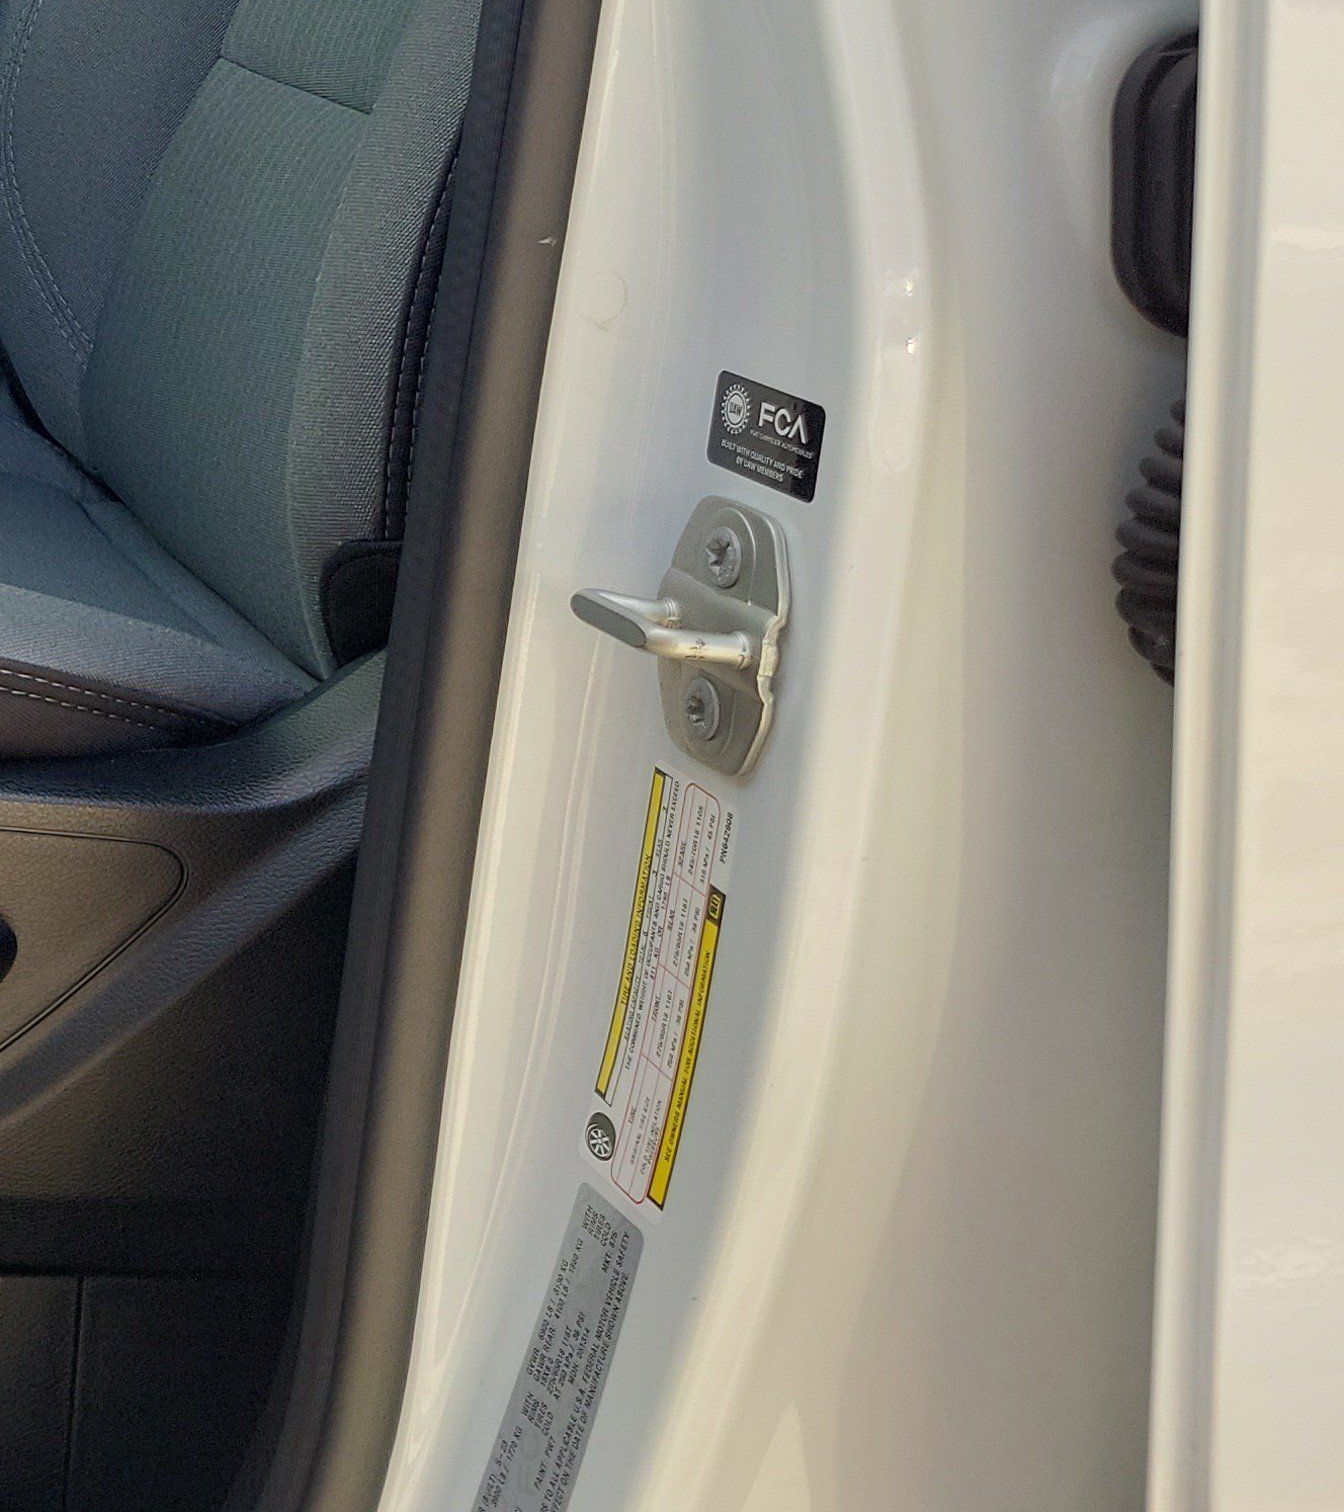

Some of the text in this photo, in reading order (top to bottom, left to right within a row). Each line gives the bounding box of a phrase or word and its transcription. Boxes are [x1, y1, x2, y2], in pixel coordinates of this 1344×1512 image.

[758, 400, 809, 444] FCA
[599, 1221, 611, 1247] COLD
[543, 1488, 553, 1501] TO
[548, 1471, 559, 1488] ALL
[554, 1413, 577, 1469] APPLICABLE
[581, 1342, 598, 1383] FEDERAL
[594, 1306, 609, 1341] MOTOR
[604, 1267, 620, 1306] VEHICLE
[615, 1231, 630, 1267] SAFETY
[560, 1271, 628, 1485] ON THE DATE OF MANUFACTURE SHOWN ABOVE
[520, 1392, 533, 1417] WITH
[541, 1411, 553, 1435] COLD
